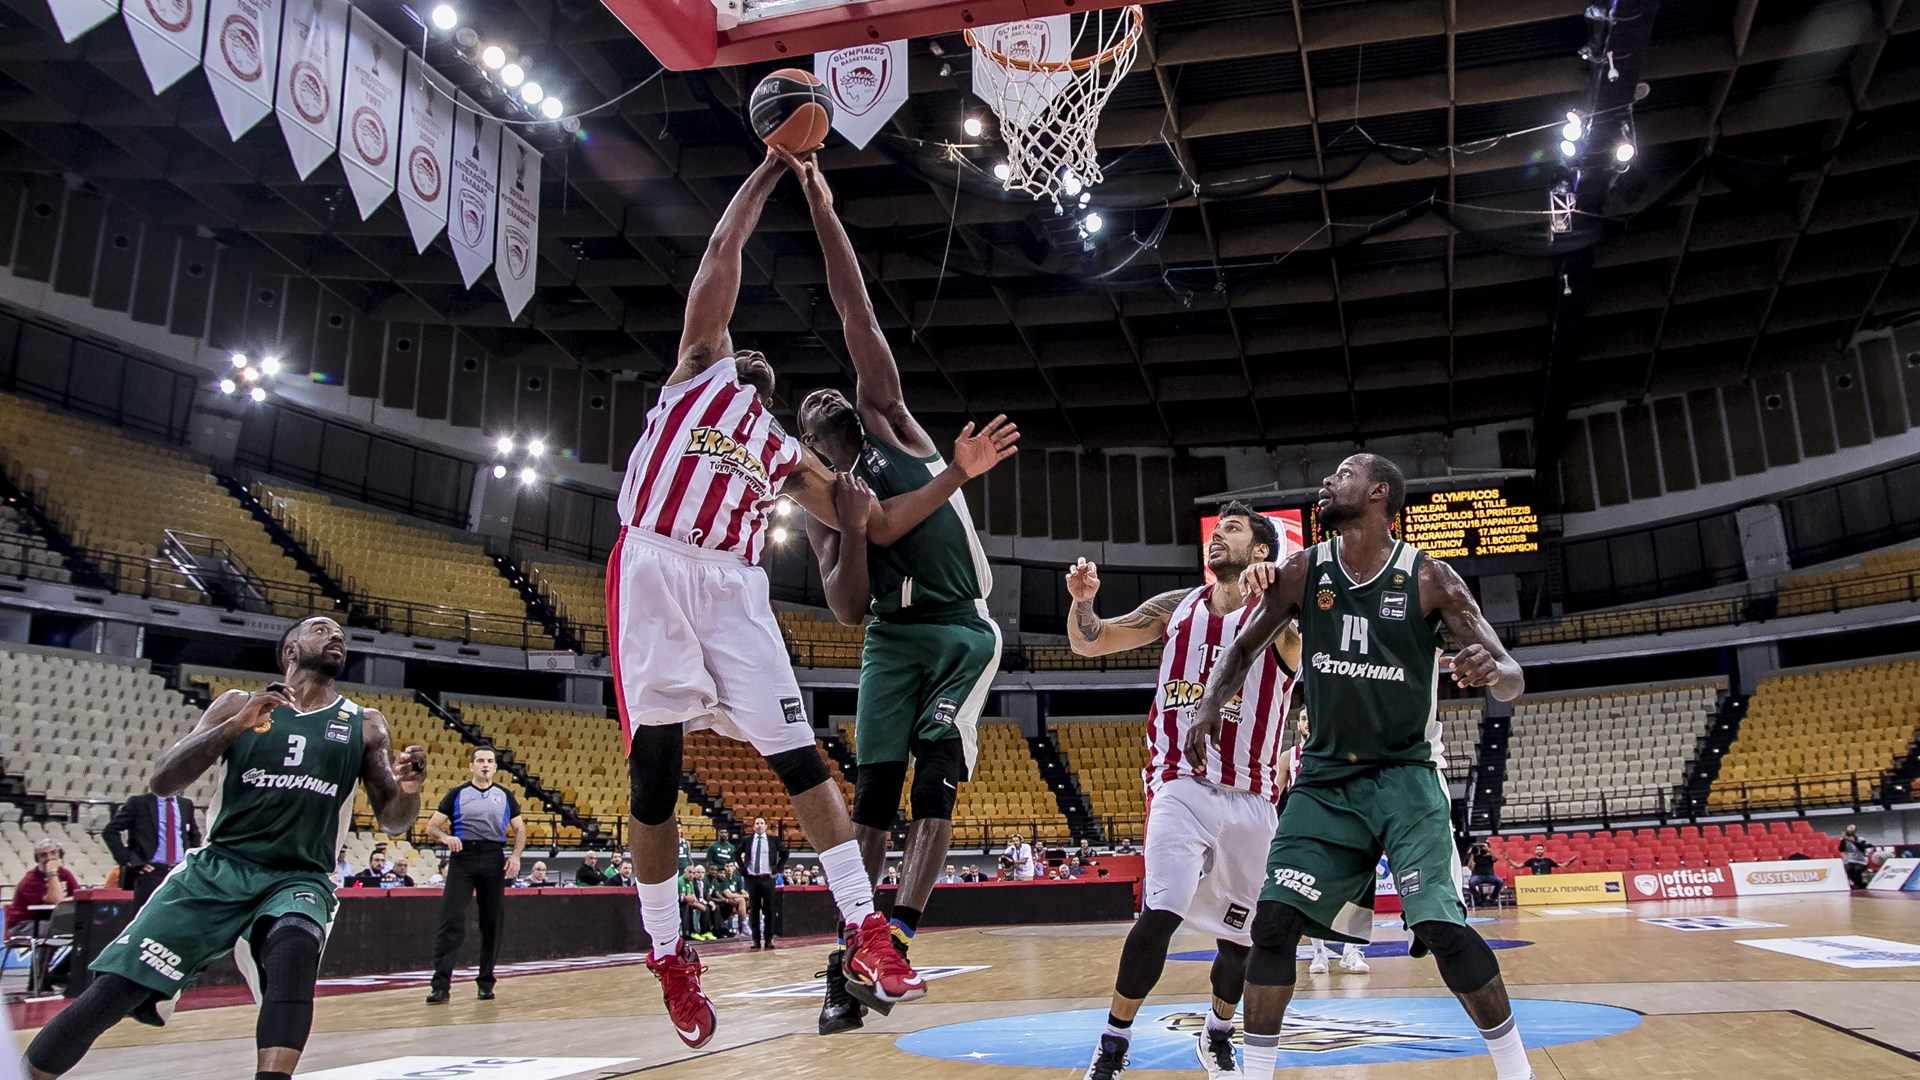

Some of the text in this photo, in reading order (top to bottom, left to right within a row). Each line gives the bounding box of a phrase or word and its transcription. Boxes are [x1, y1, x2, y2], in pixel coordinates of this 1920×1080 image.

[833, 47, 885, 62] OLYMPIACOS
[841, 56, 878, 66] BASKETBALL
[742, 412, 756, 435] 1
[710, 461, 730, 473] Τύχη
[731, 467, 744, 478] στη
[1431, 489, 1500, 503] OLYMPIACOS
[1405, 504, 1447, 514] 1.MCLEAN
[1472, 499, 1507, 509] 14.TILLE
[1405, 511, 1473, 523] 4.TOLIOPOULOS
[1475, 506, 1531, 518] 15.PRINTEZIS
[1405, 530, 1465, 541] 10.AGRAVANIS
[1478, 524, 1538, 536] 17.MANTZARIS
[1480, 534, 1526, 545] 31.BOGRIS
[1476, 543, 1538, 555] 34.THOMPSON
[1340, 614, 1368, 654] 14
[283, 734, 307, 767] 3
[1274, 868, 1316, 886] TOYO
[1663, 868, 1725, 885] official
[1751, 870, 1820, 885] SUSTENIUM
[1275, 876, 1322, 901] TIRES
[1519, 885, 1600, 894] ΤΡΑΠΕΖΑ ΠΕΙΡΑΙΩΣ
[1667, 884, 1714, 898] store
[139, 937, 182, 967] TOYO
[139, 951, 184, 981] TIRES
